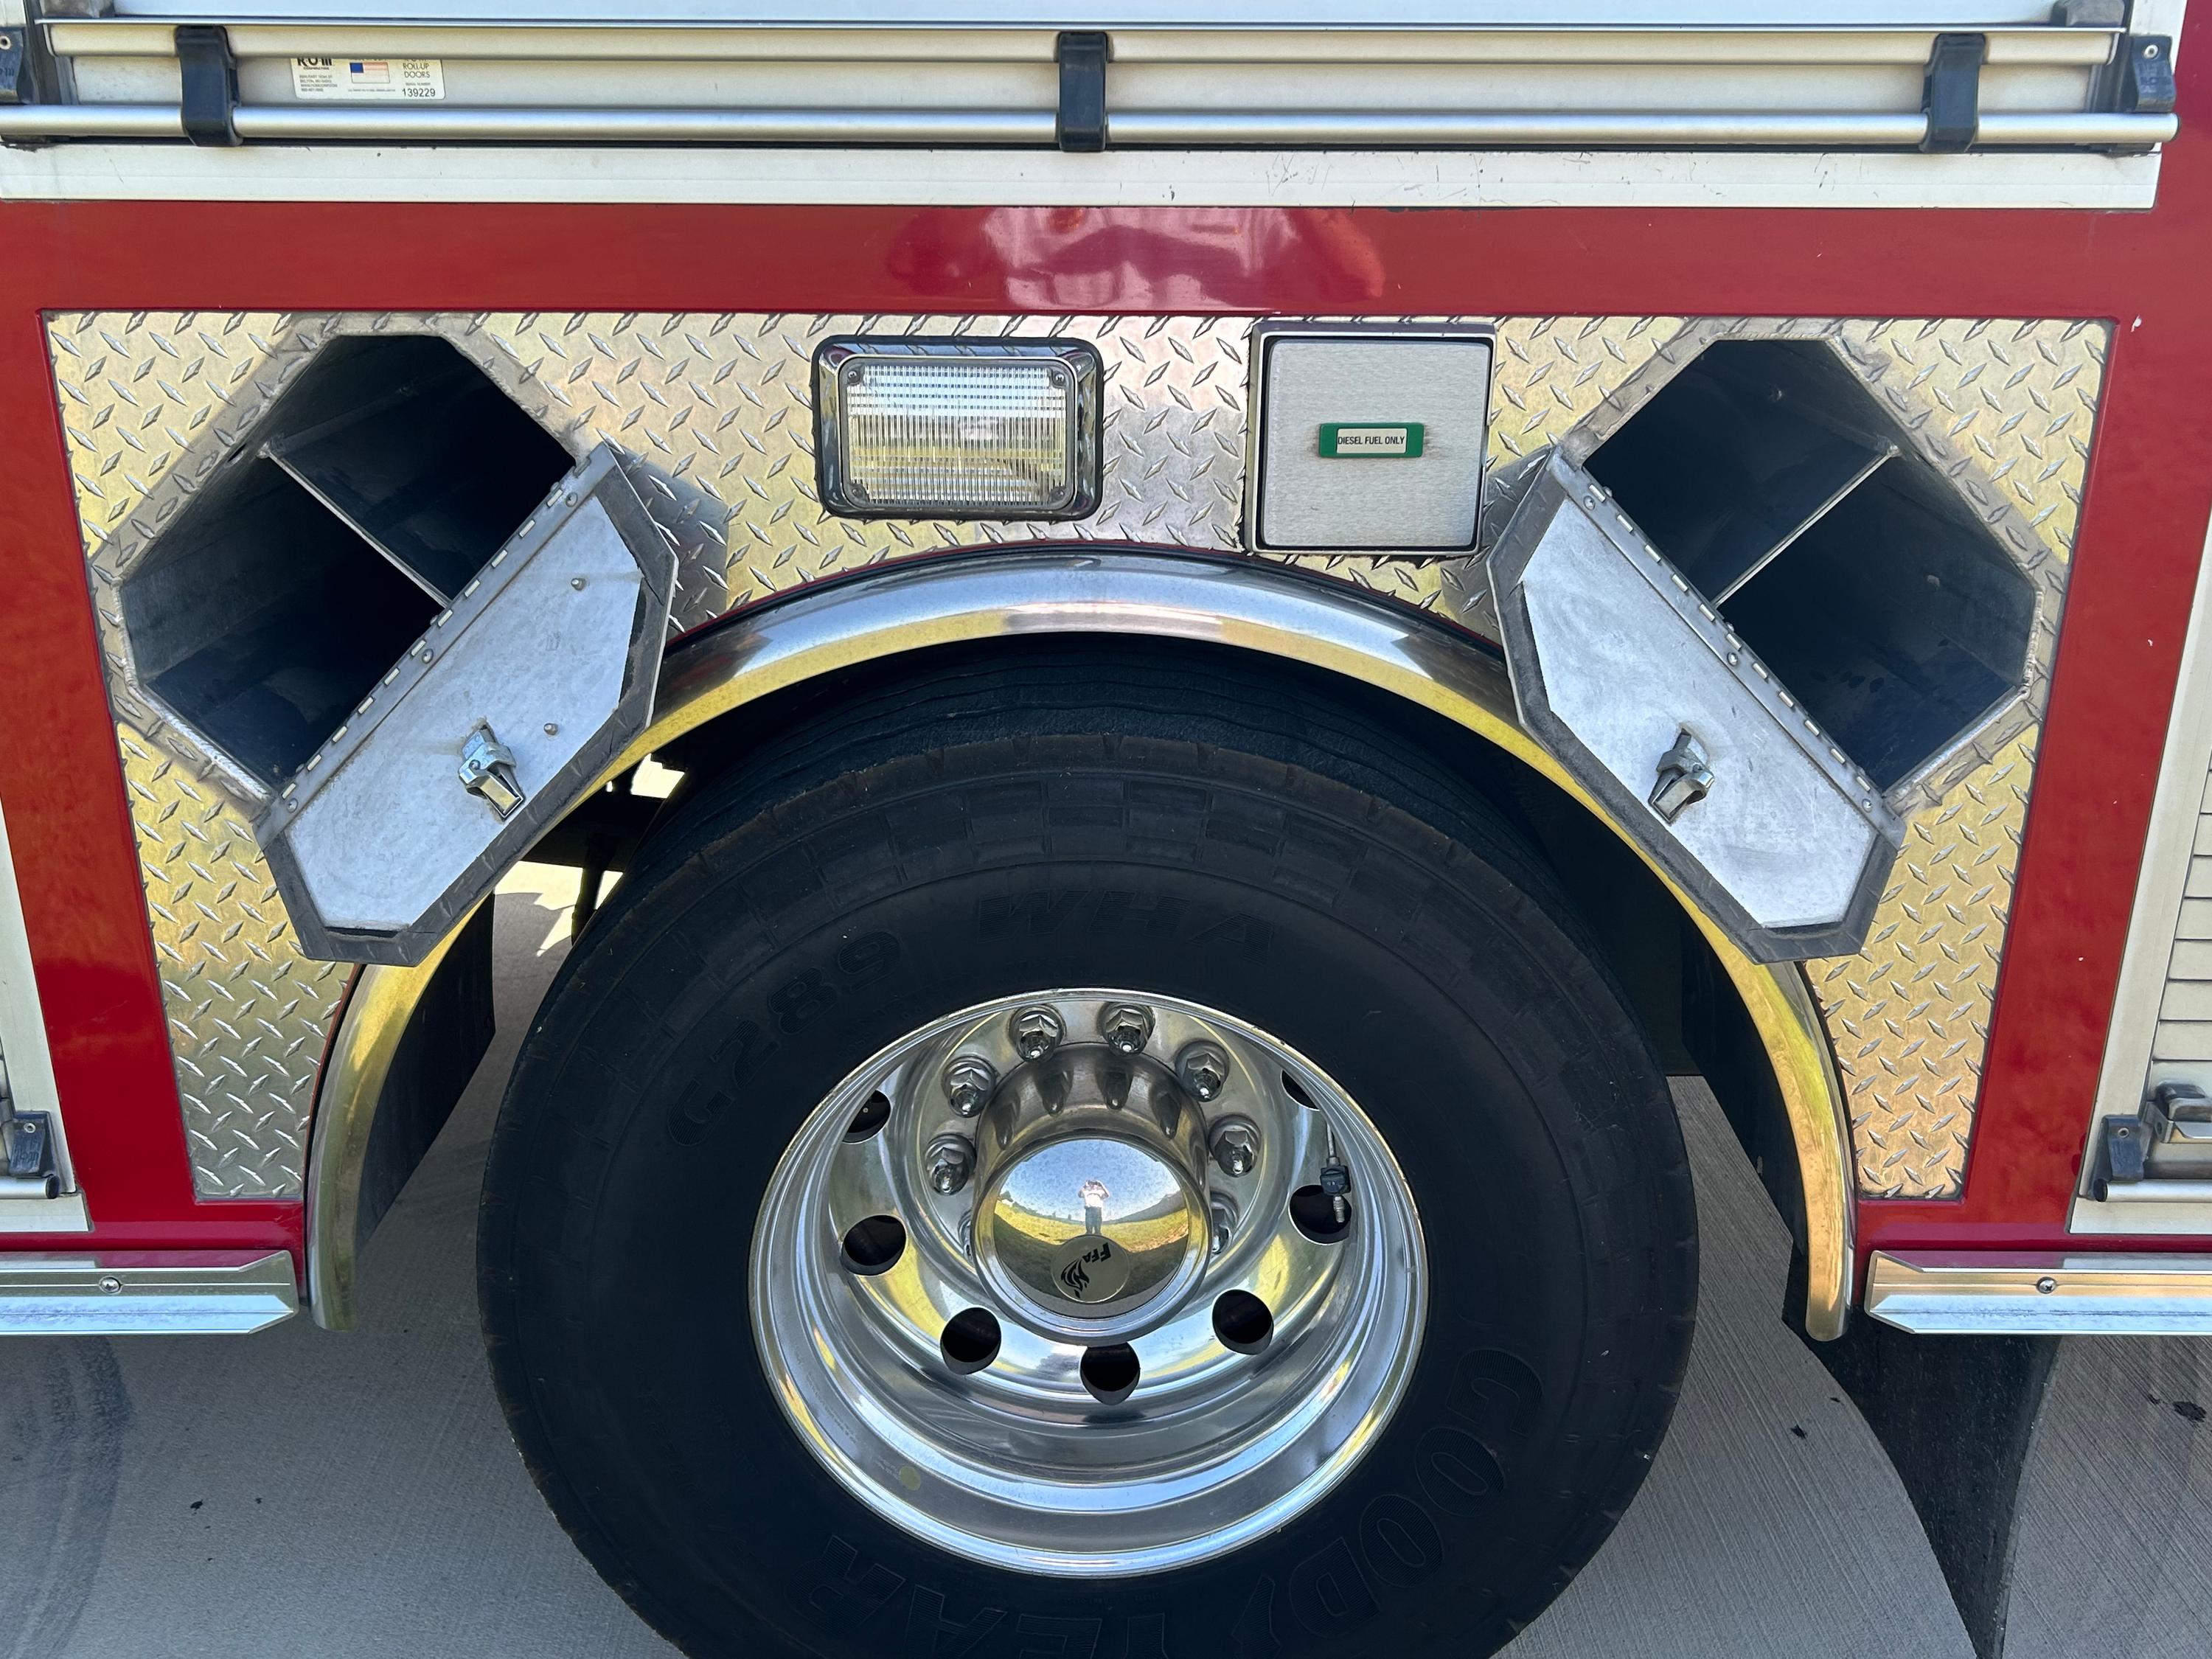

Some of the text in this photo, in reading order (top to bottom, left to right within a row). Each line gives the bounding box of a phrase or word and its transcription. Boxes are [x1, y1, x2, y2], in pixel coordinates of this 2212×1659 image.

[402, 88, 436, 97] 139229
[1338, 436, 1405, 445] DIESEL FUEL ONLY
[667, 931, 901, 1148] G289
[977, 888, 1276, 967] WHA
[1082, 1242, 1111, 1263] FFA
